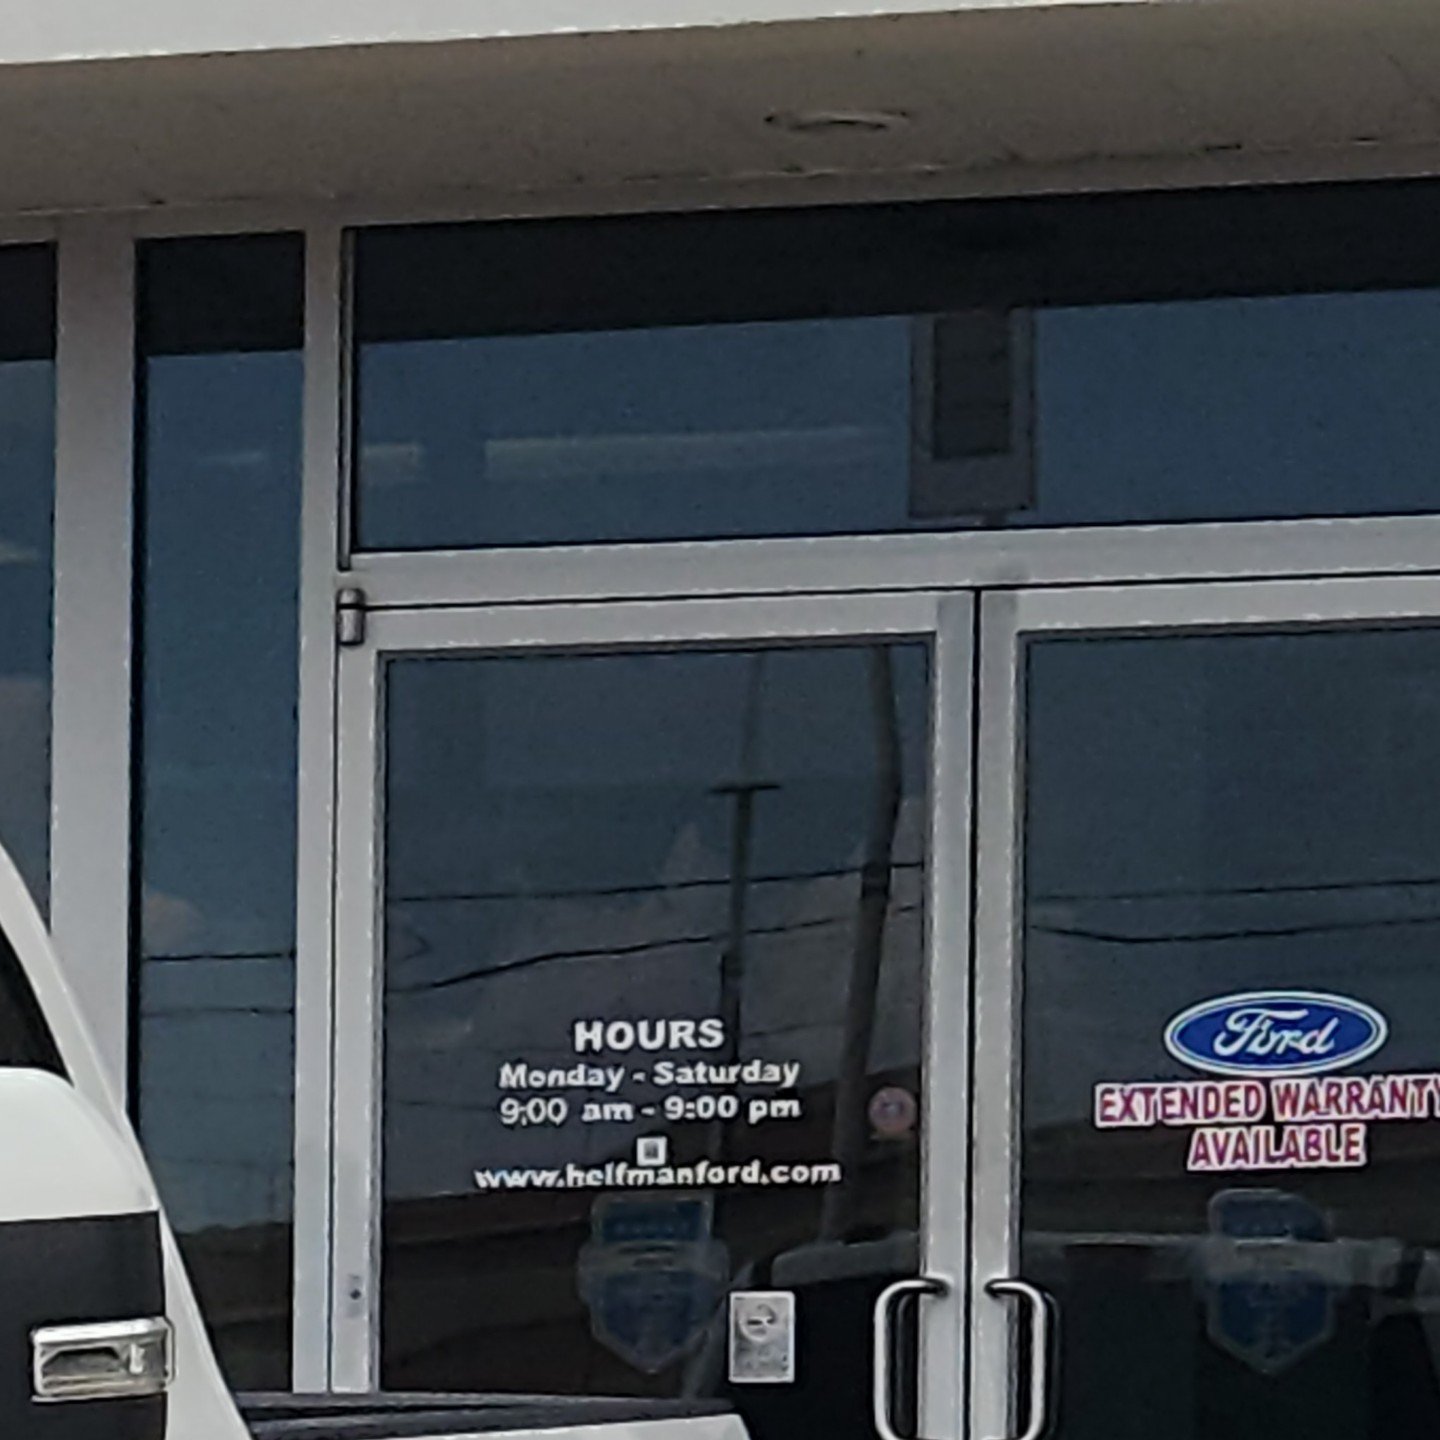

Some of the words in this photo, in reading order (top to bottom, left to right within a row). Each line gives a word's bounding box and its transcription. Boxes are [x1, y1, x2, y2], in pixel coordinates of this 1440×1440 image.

[573, 1018, 725, 1052] HOURS
[1212, 1008, 1340, 1057] Ford
[498, 1062, 625, 1092] Monday
[653, 1059, 800, 1088] Saturday
[499, 1098, 569, 1127] 9:00
[581, 1103, 634, 1122] am
[663, 1095, 739, 1121] 9:00
[748, 1097, 802, 1126] pm
[1097, 1081, 1265, 1123] EXTENDED
[1190, 1125, 1363, 1168] AVAILABLE
[474, 1160, 843, 1189] www.helfmanford.com
